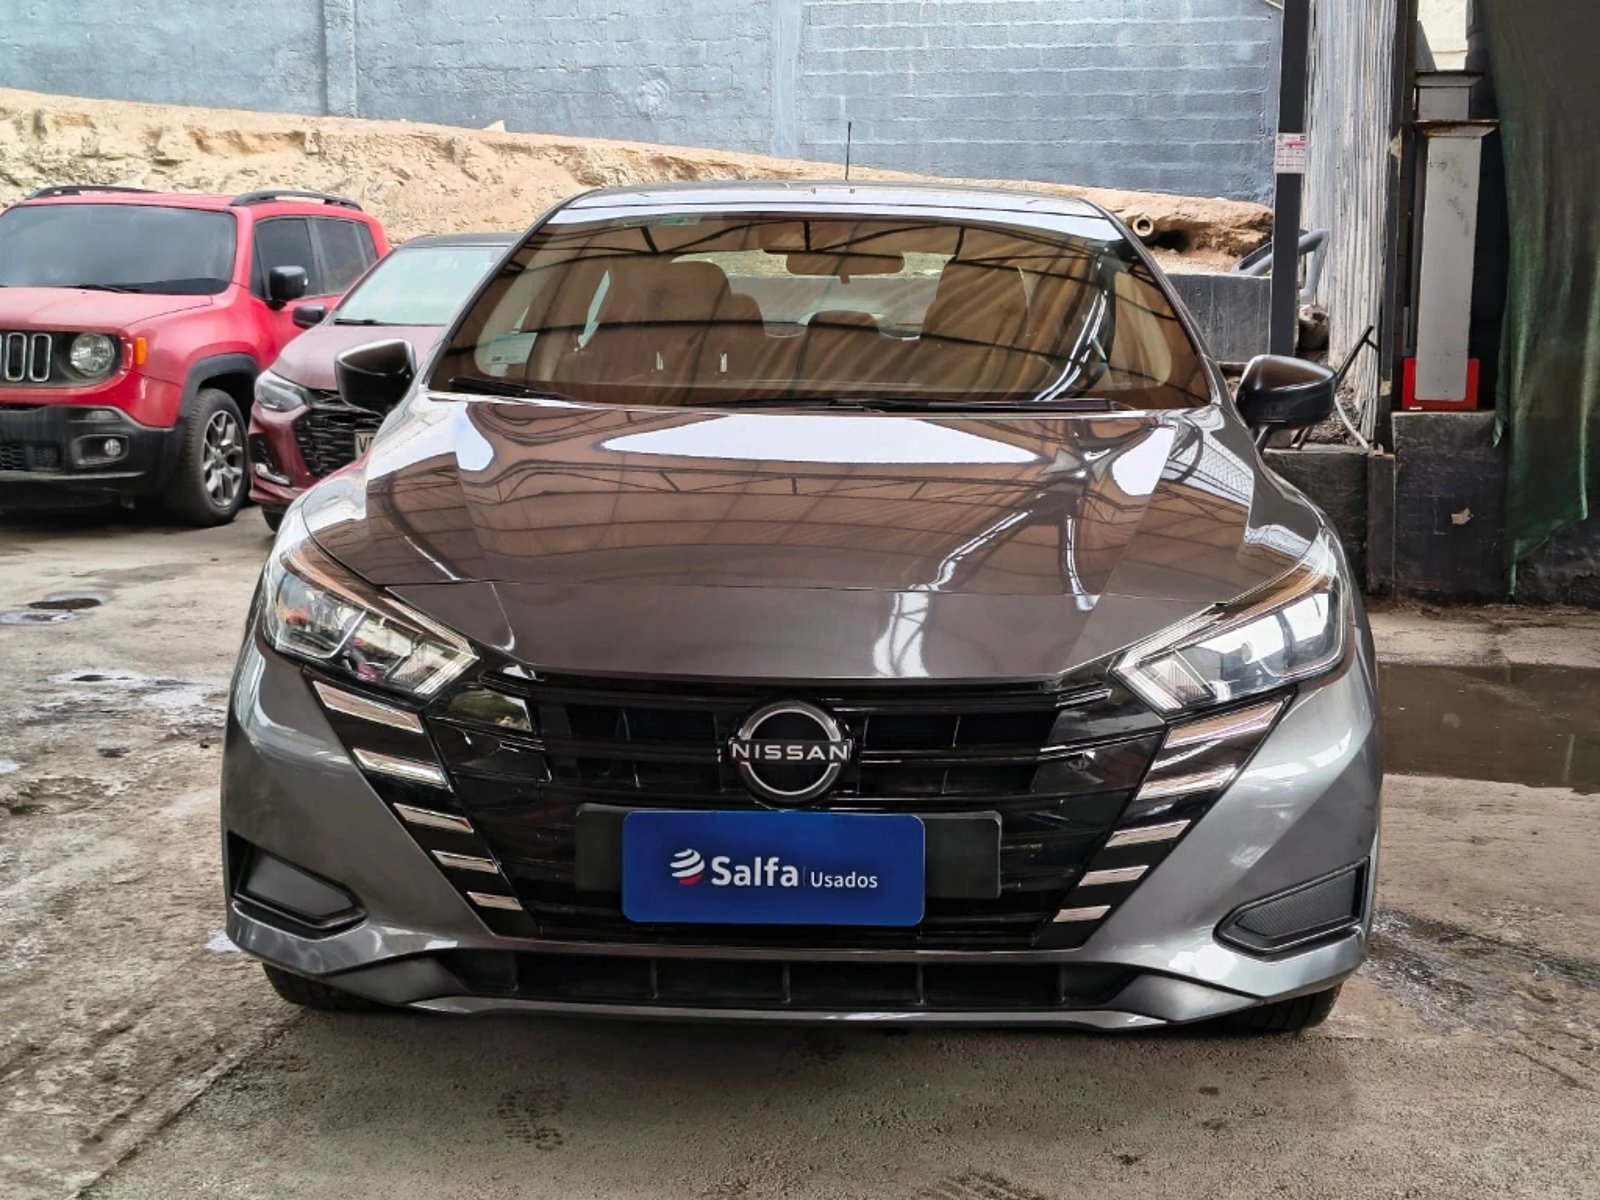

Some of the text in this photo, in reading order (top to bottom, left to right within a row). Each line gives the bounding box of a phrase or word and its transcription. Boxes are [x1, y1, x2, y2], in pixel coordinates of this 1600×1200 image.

[732, 743, 848, 760] NISSAN
[711, 856, 878, 888] Salfa Usados
